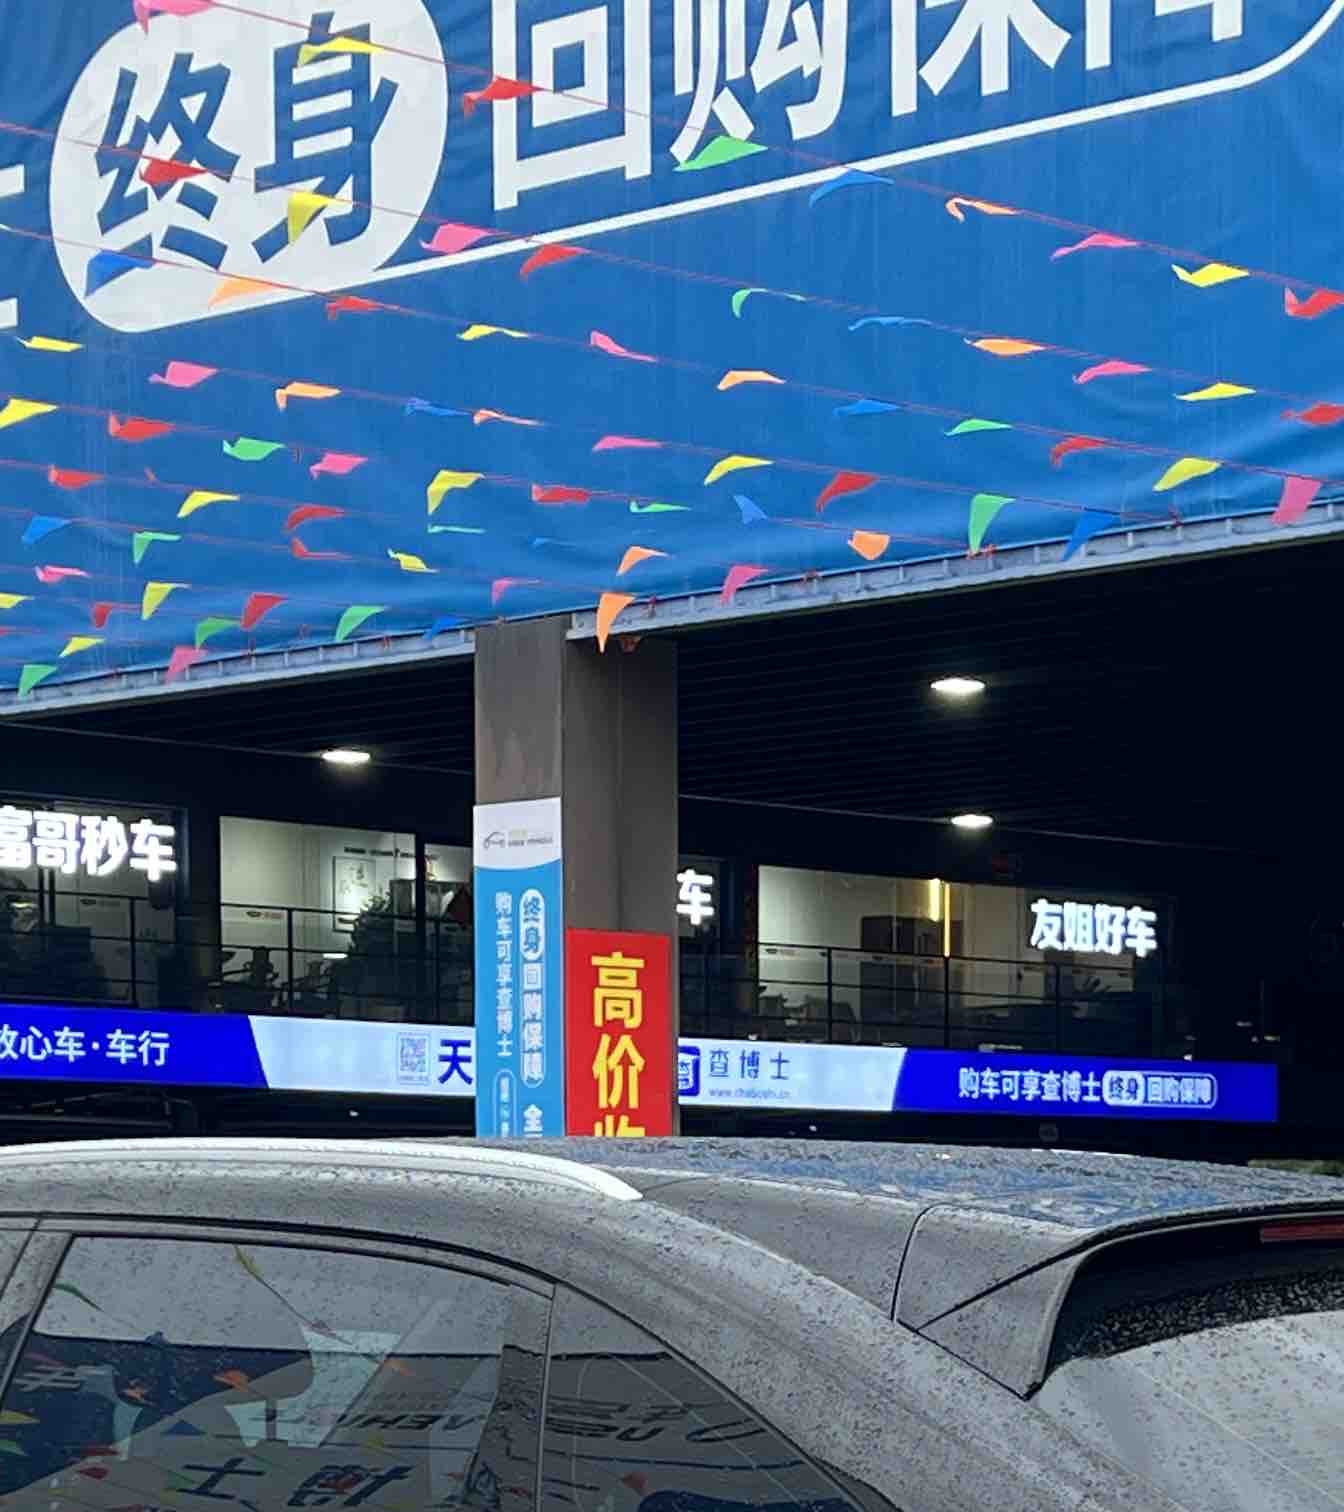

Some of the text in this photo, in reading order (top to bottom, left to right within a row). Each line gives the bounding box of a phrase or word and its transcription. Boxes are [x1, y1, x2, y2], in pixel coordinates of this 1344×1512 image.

[95, 8, 400, 271] 终身
[676, 868, 715, 926] 车
[438, 1039, 473, 1085] 天
[709, 1048, 791, 1080] 查博士
[958, 1067, 1101, 1102] 购车可享查博士
